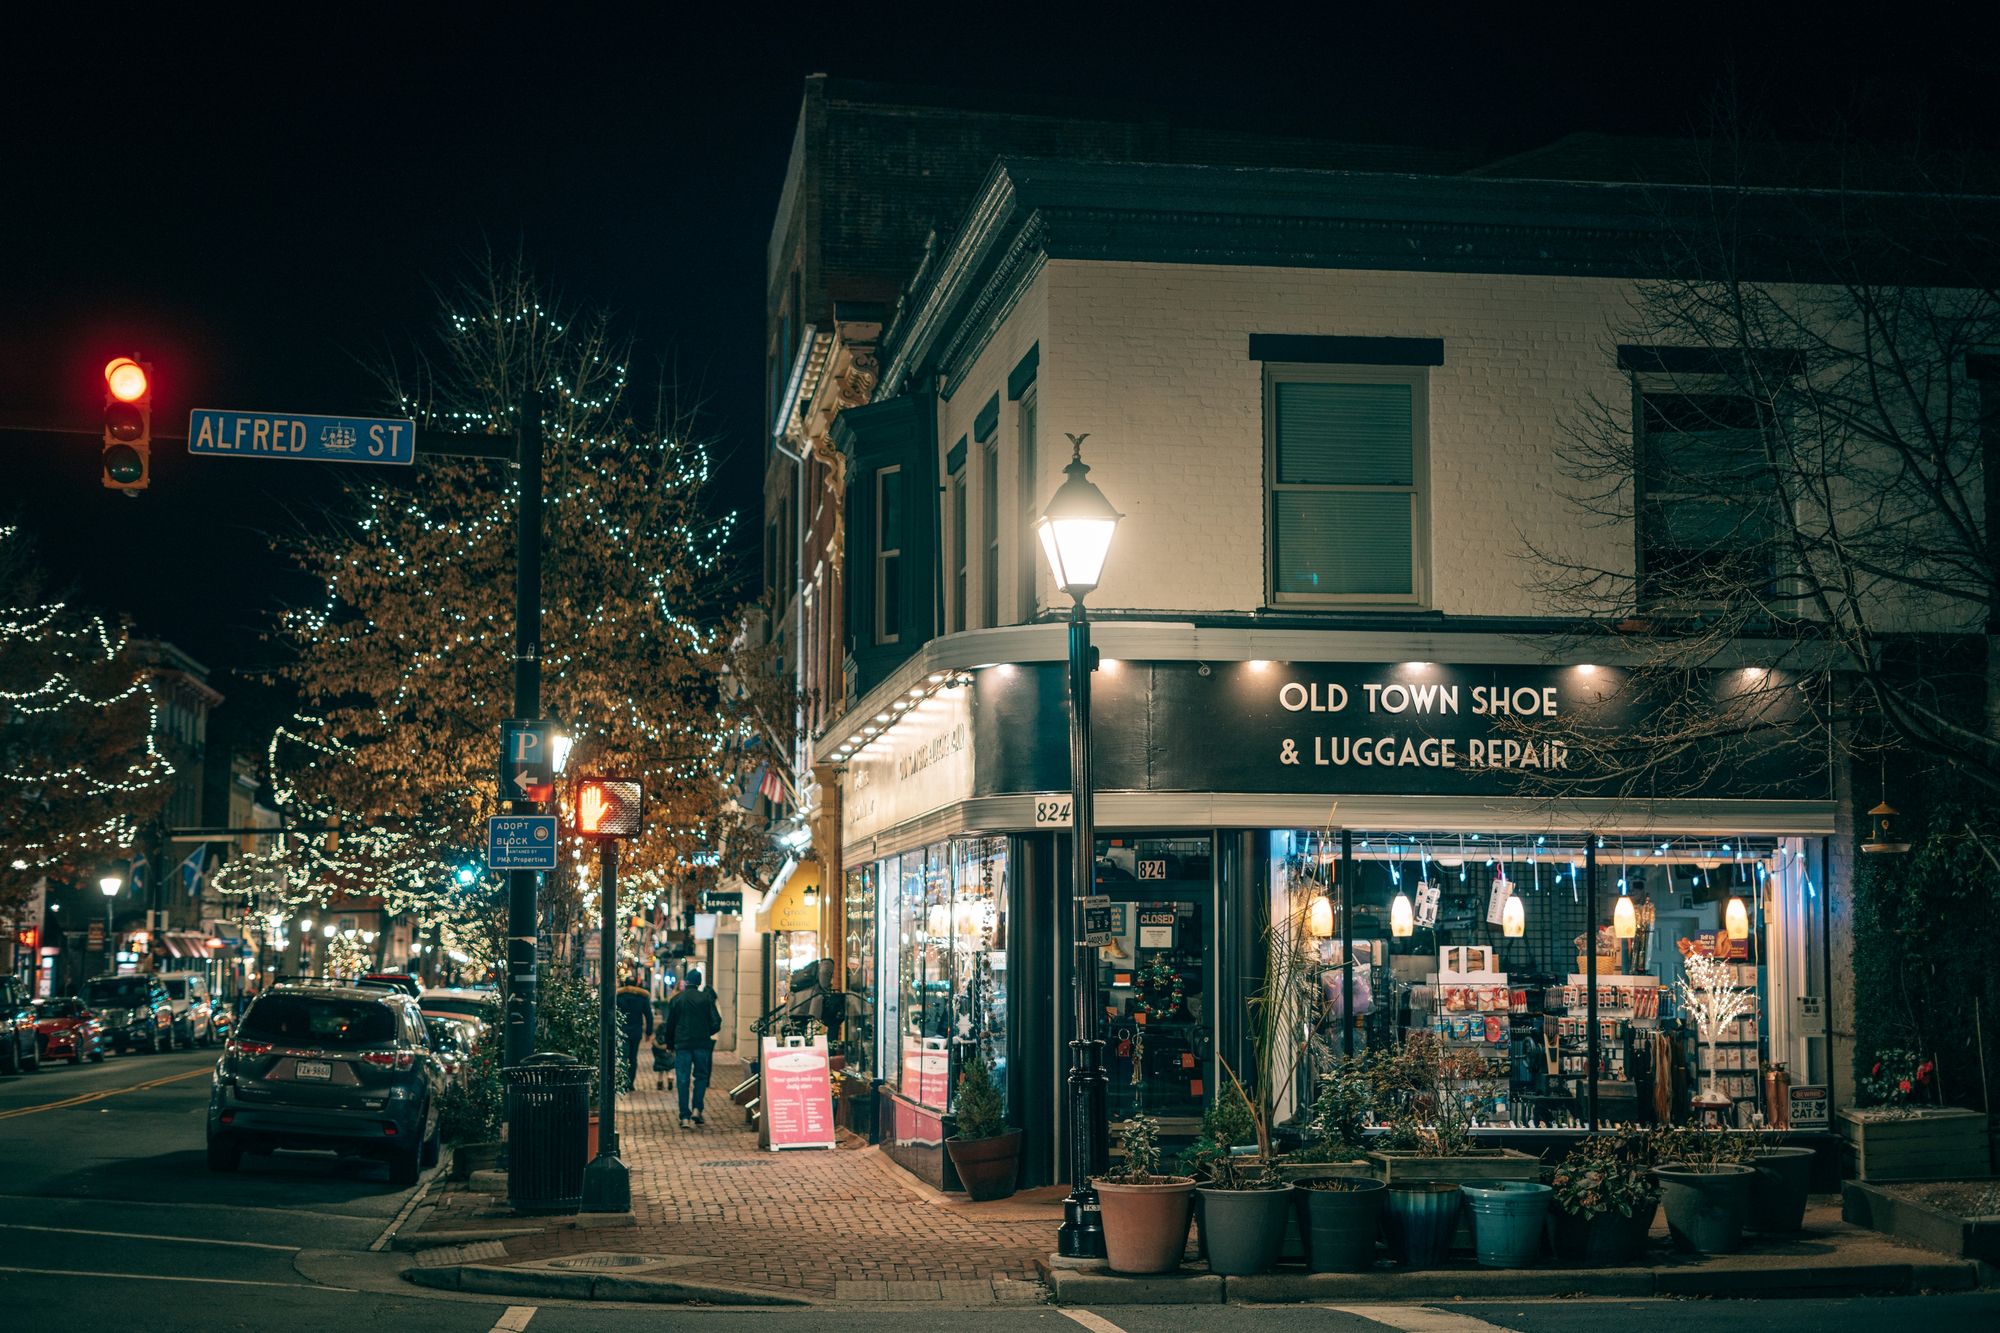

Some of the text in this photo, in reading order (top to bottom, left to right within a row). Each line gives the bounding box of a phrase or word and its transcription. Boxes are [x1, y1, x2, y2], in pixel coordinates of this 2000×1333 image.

[196, 416, 403, 457] ALFRED ST
[1279, 682, 1558, 716] OLD TOWN SHOE
[516, 733, 538, 760] P
[1279, 737, 1568, 769] & LUGGAGE REPAIR
[1037, 802, 1071, 822] 824
[496, 822, 529, 830] ADOPT
[496, 837, 528, 845] BLOCK
[1140, 861, 1164, 878] 824
[1140, 914, 1174, 924] CLOSED
[1792, 1109, 1813, 1118] CAT
